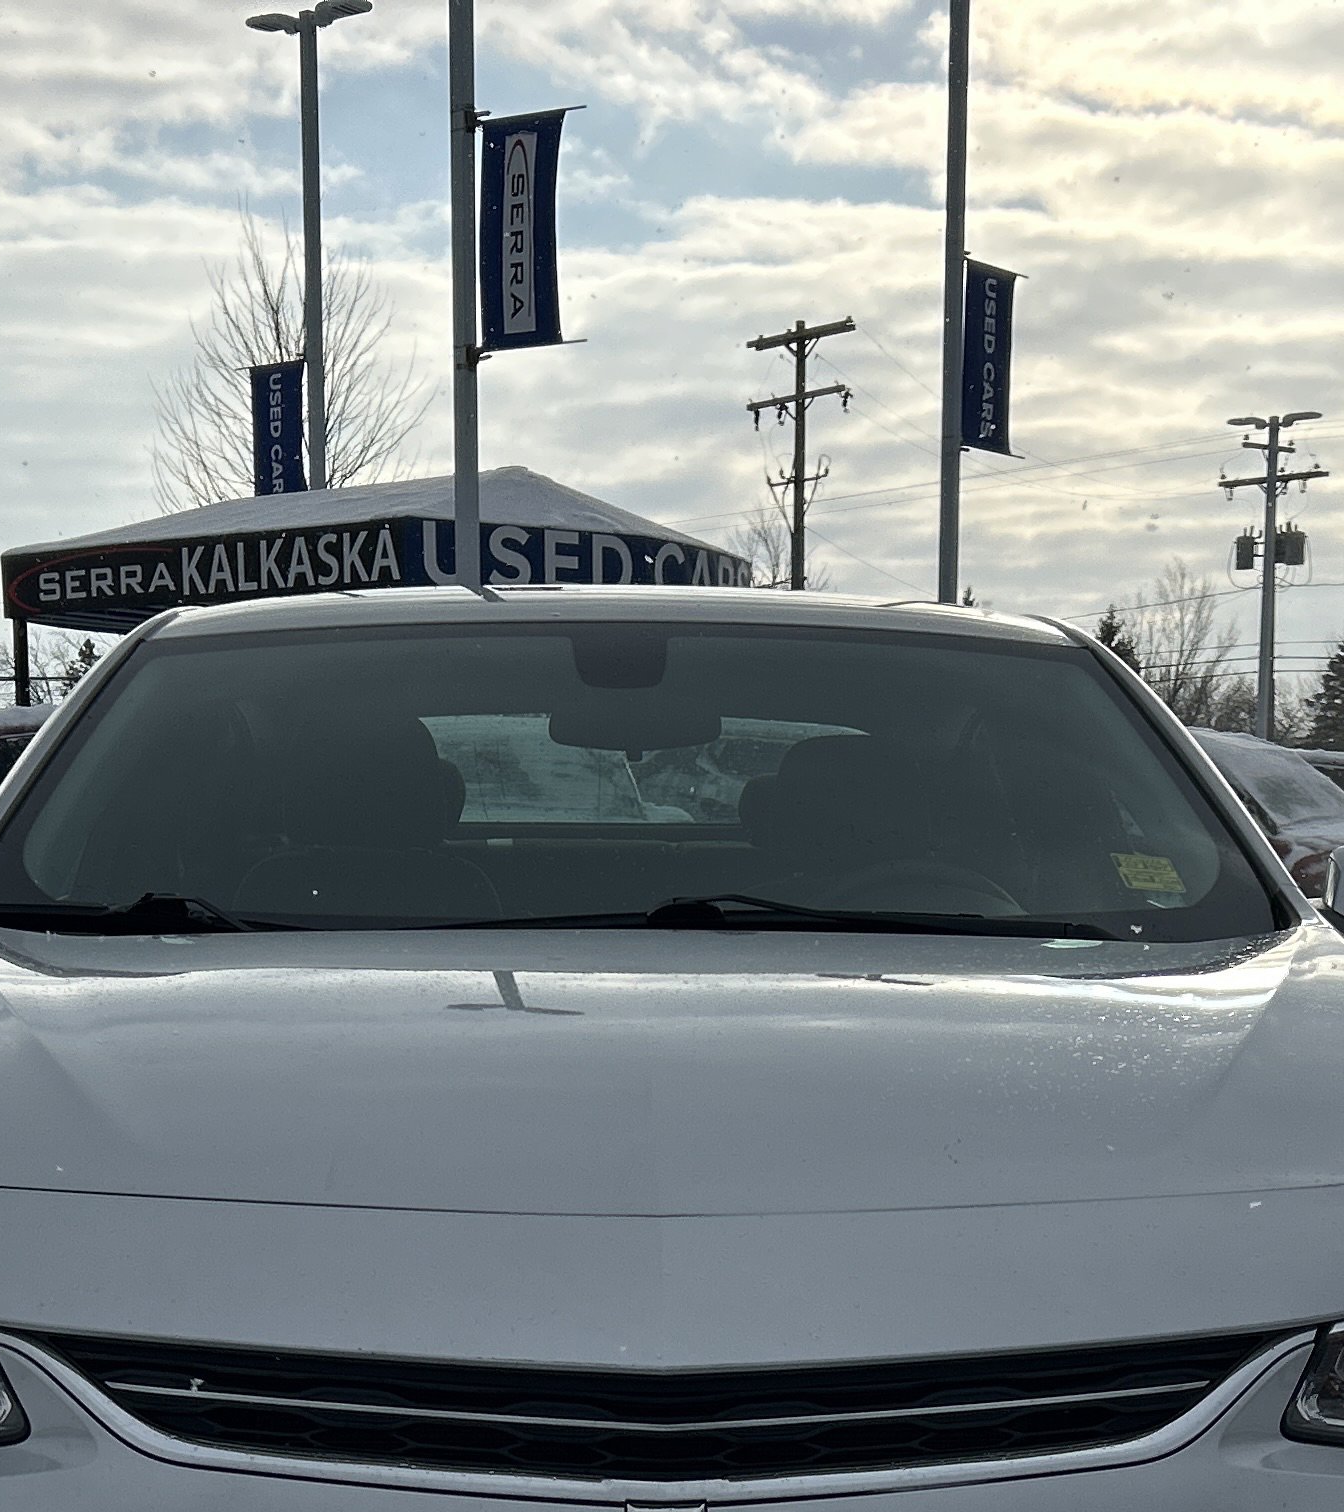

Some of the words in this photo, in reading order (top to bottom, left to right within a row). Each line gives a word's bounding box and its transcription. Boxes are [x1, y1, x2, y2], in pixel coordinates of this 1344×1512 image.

[509, 172, 526, 319] SERRA
[984, 278, 998, 354] USED
[269, 373, 283, 438] USED
[979, 361, 995, 439] CARS
[38, 562, 177, 602] SERRA
[181, 529, 401, 596] KALKASKA
